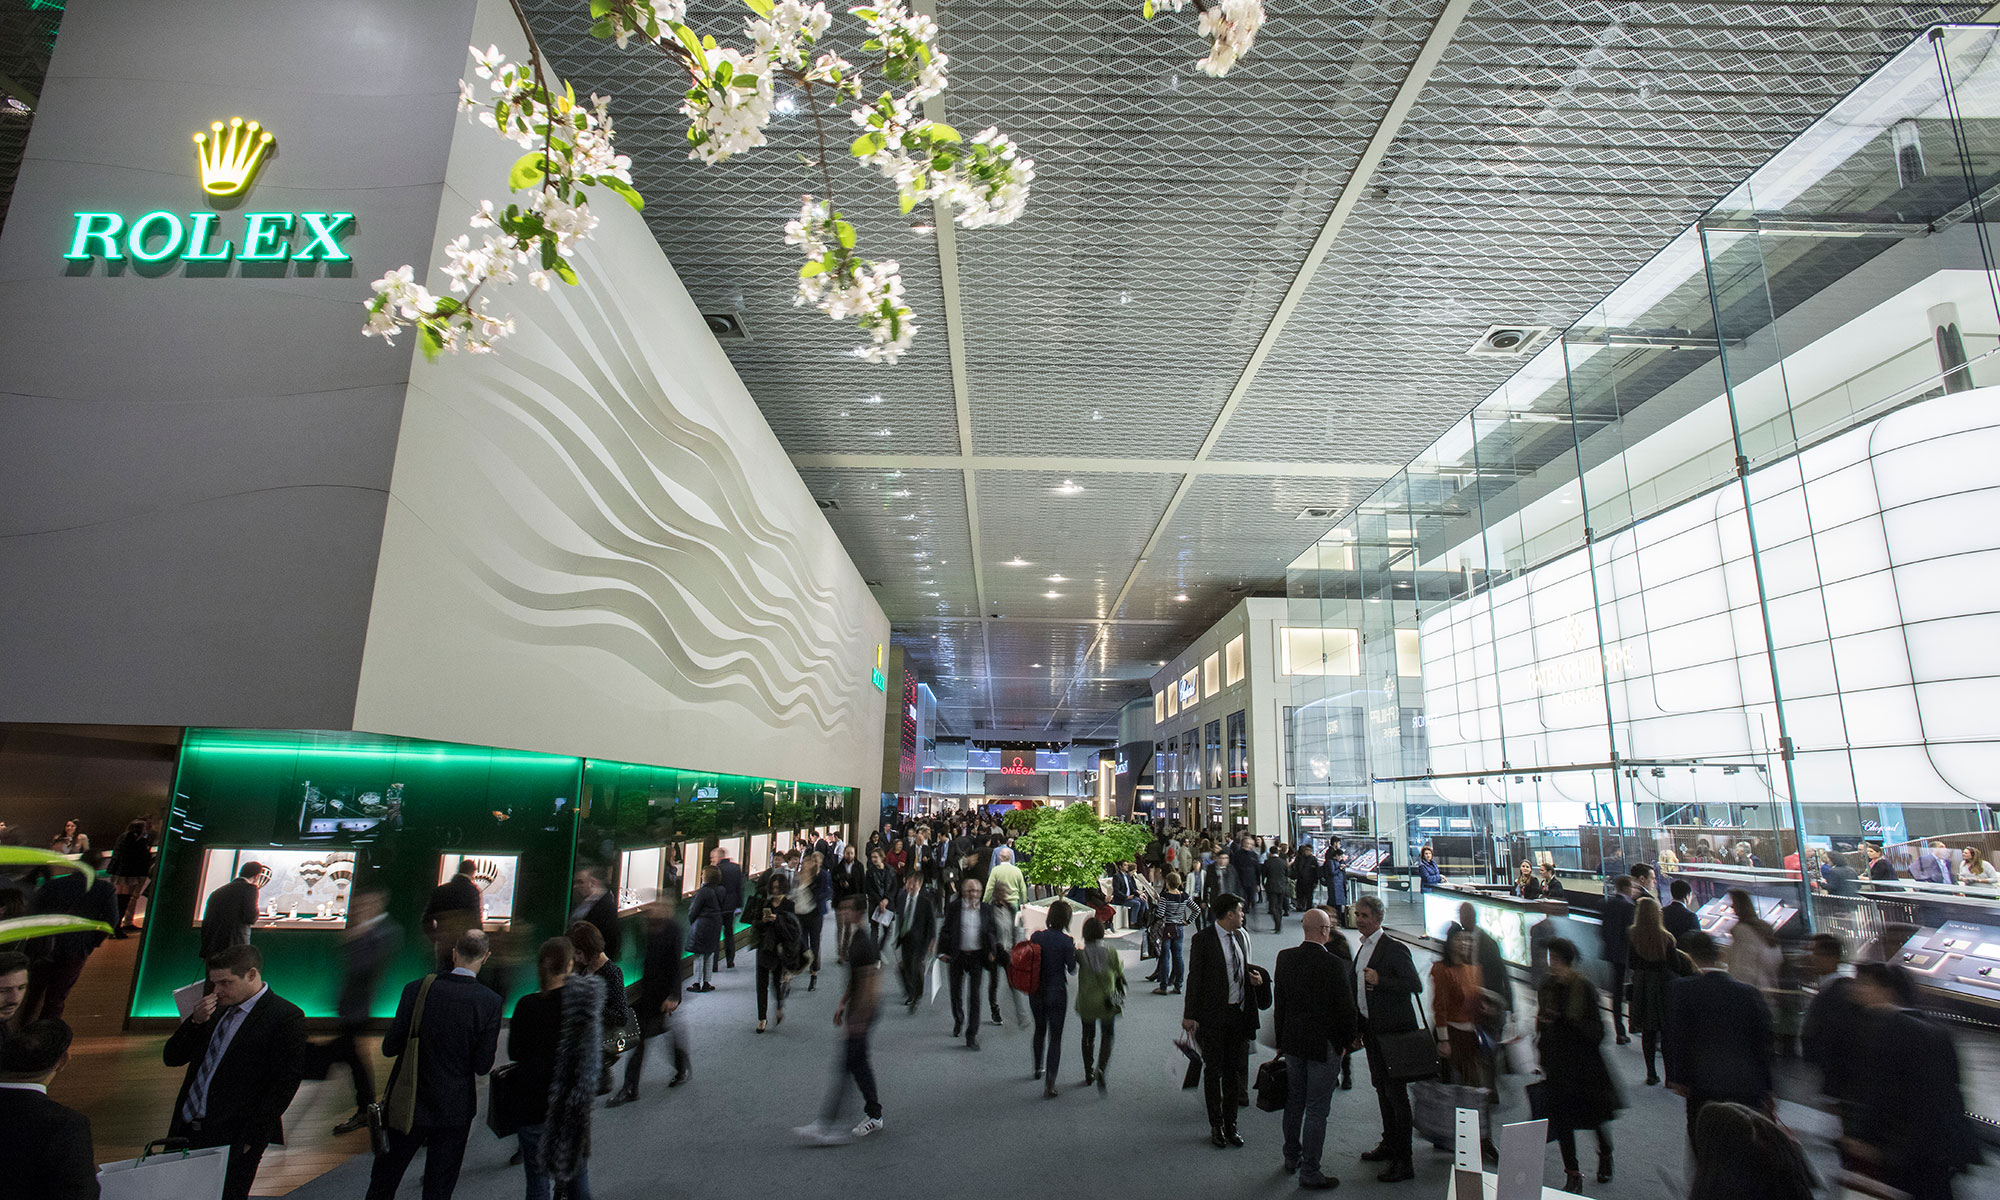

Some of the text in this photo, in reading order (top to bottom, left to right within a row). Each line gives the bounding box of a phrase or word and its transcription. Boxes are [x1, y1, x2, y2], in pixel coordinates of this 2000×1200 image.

[63, 211, 355, 262] ROLEX
[1000, 766, 1036, 776] OMEGA
[1861, 820, 1900, 834] Chopard
